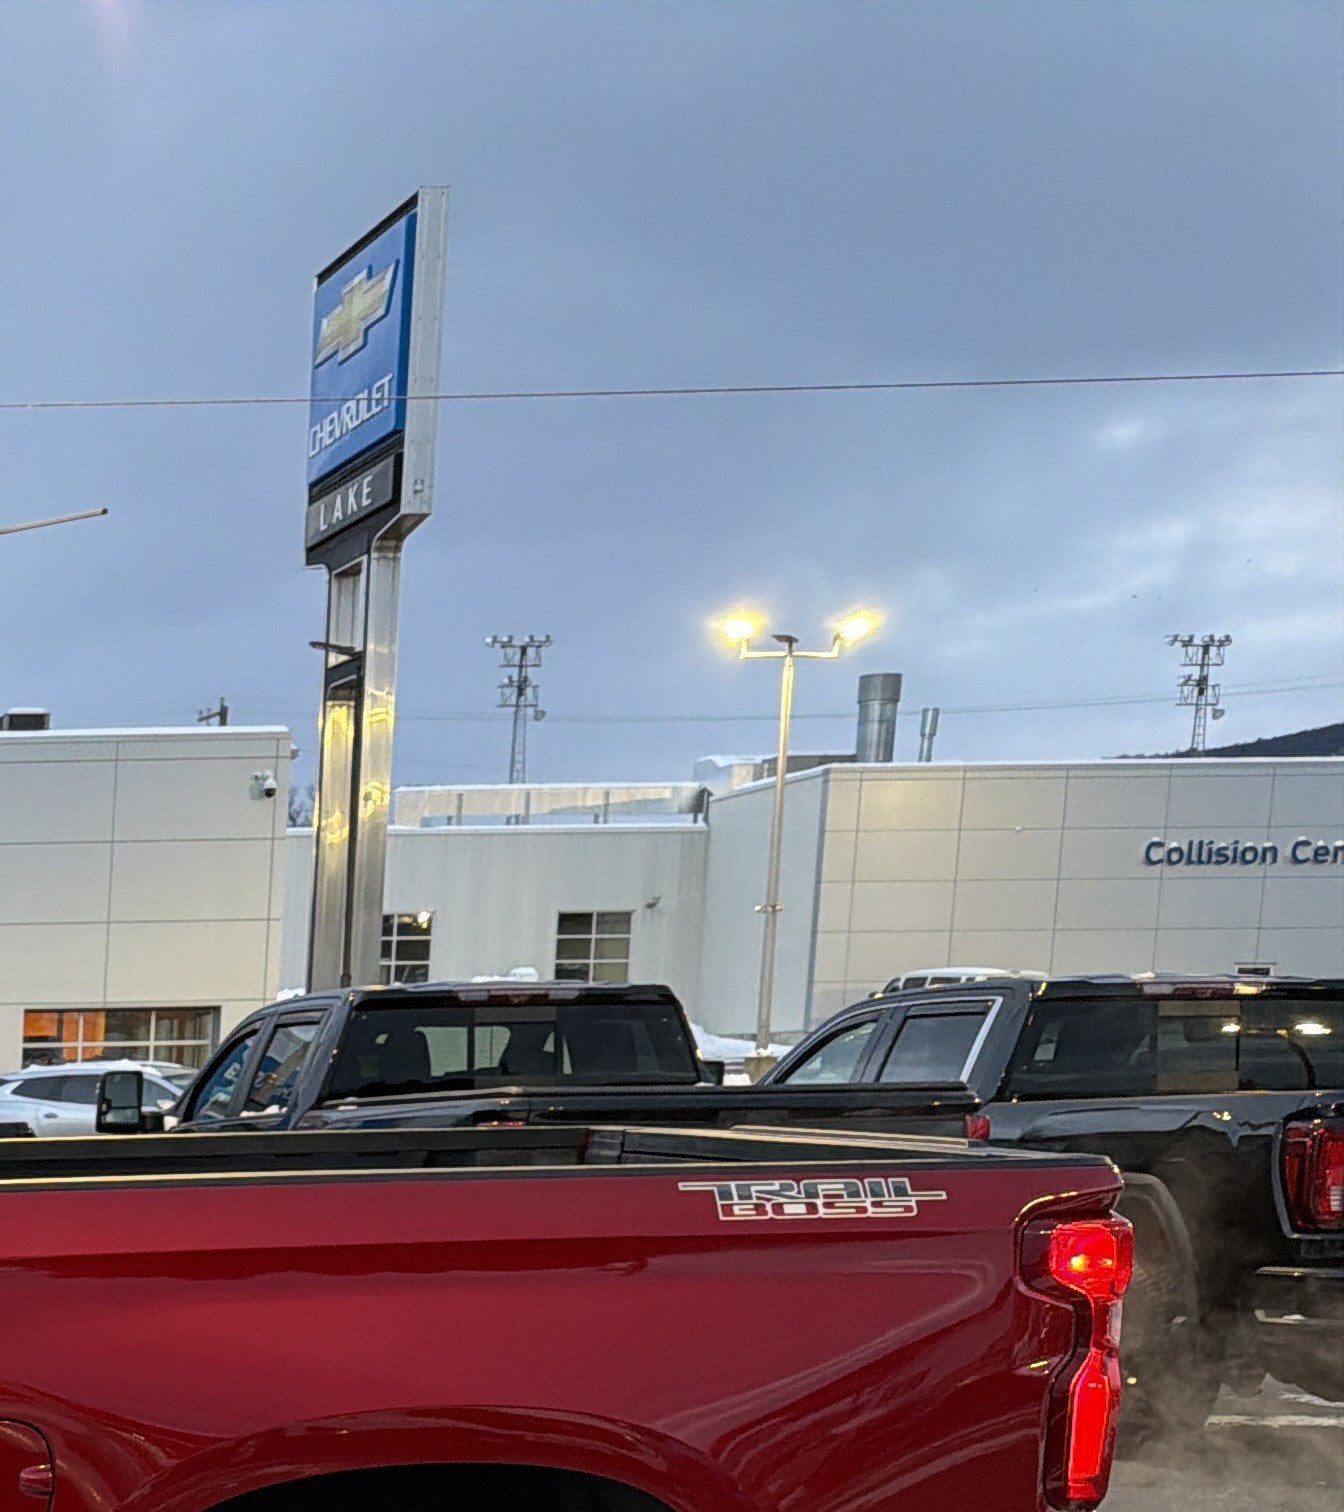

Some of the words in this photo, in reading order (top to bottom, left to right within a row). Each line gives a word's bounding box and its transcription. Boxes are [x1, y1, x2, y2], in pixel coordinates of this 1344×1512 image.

[310, 373, 394, 457] CHEVROLET
[319, 474, 374, 531] LAKE
[1144, 838, 1279, 866] Collision
[1291, 839, 1344, 865] Cen
[678, 1178, 947, 1202] TRAIL
[717, 1199, 918, 1221] BOSS
